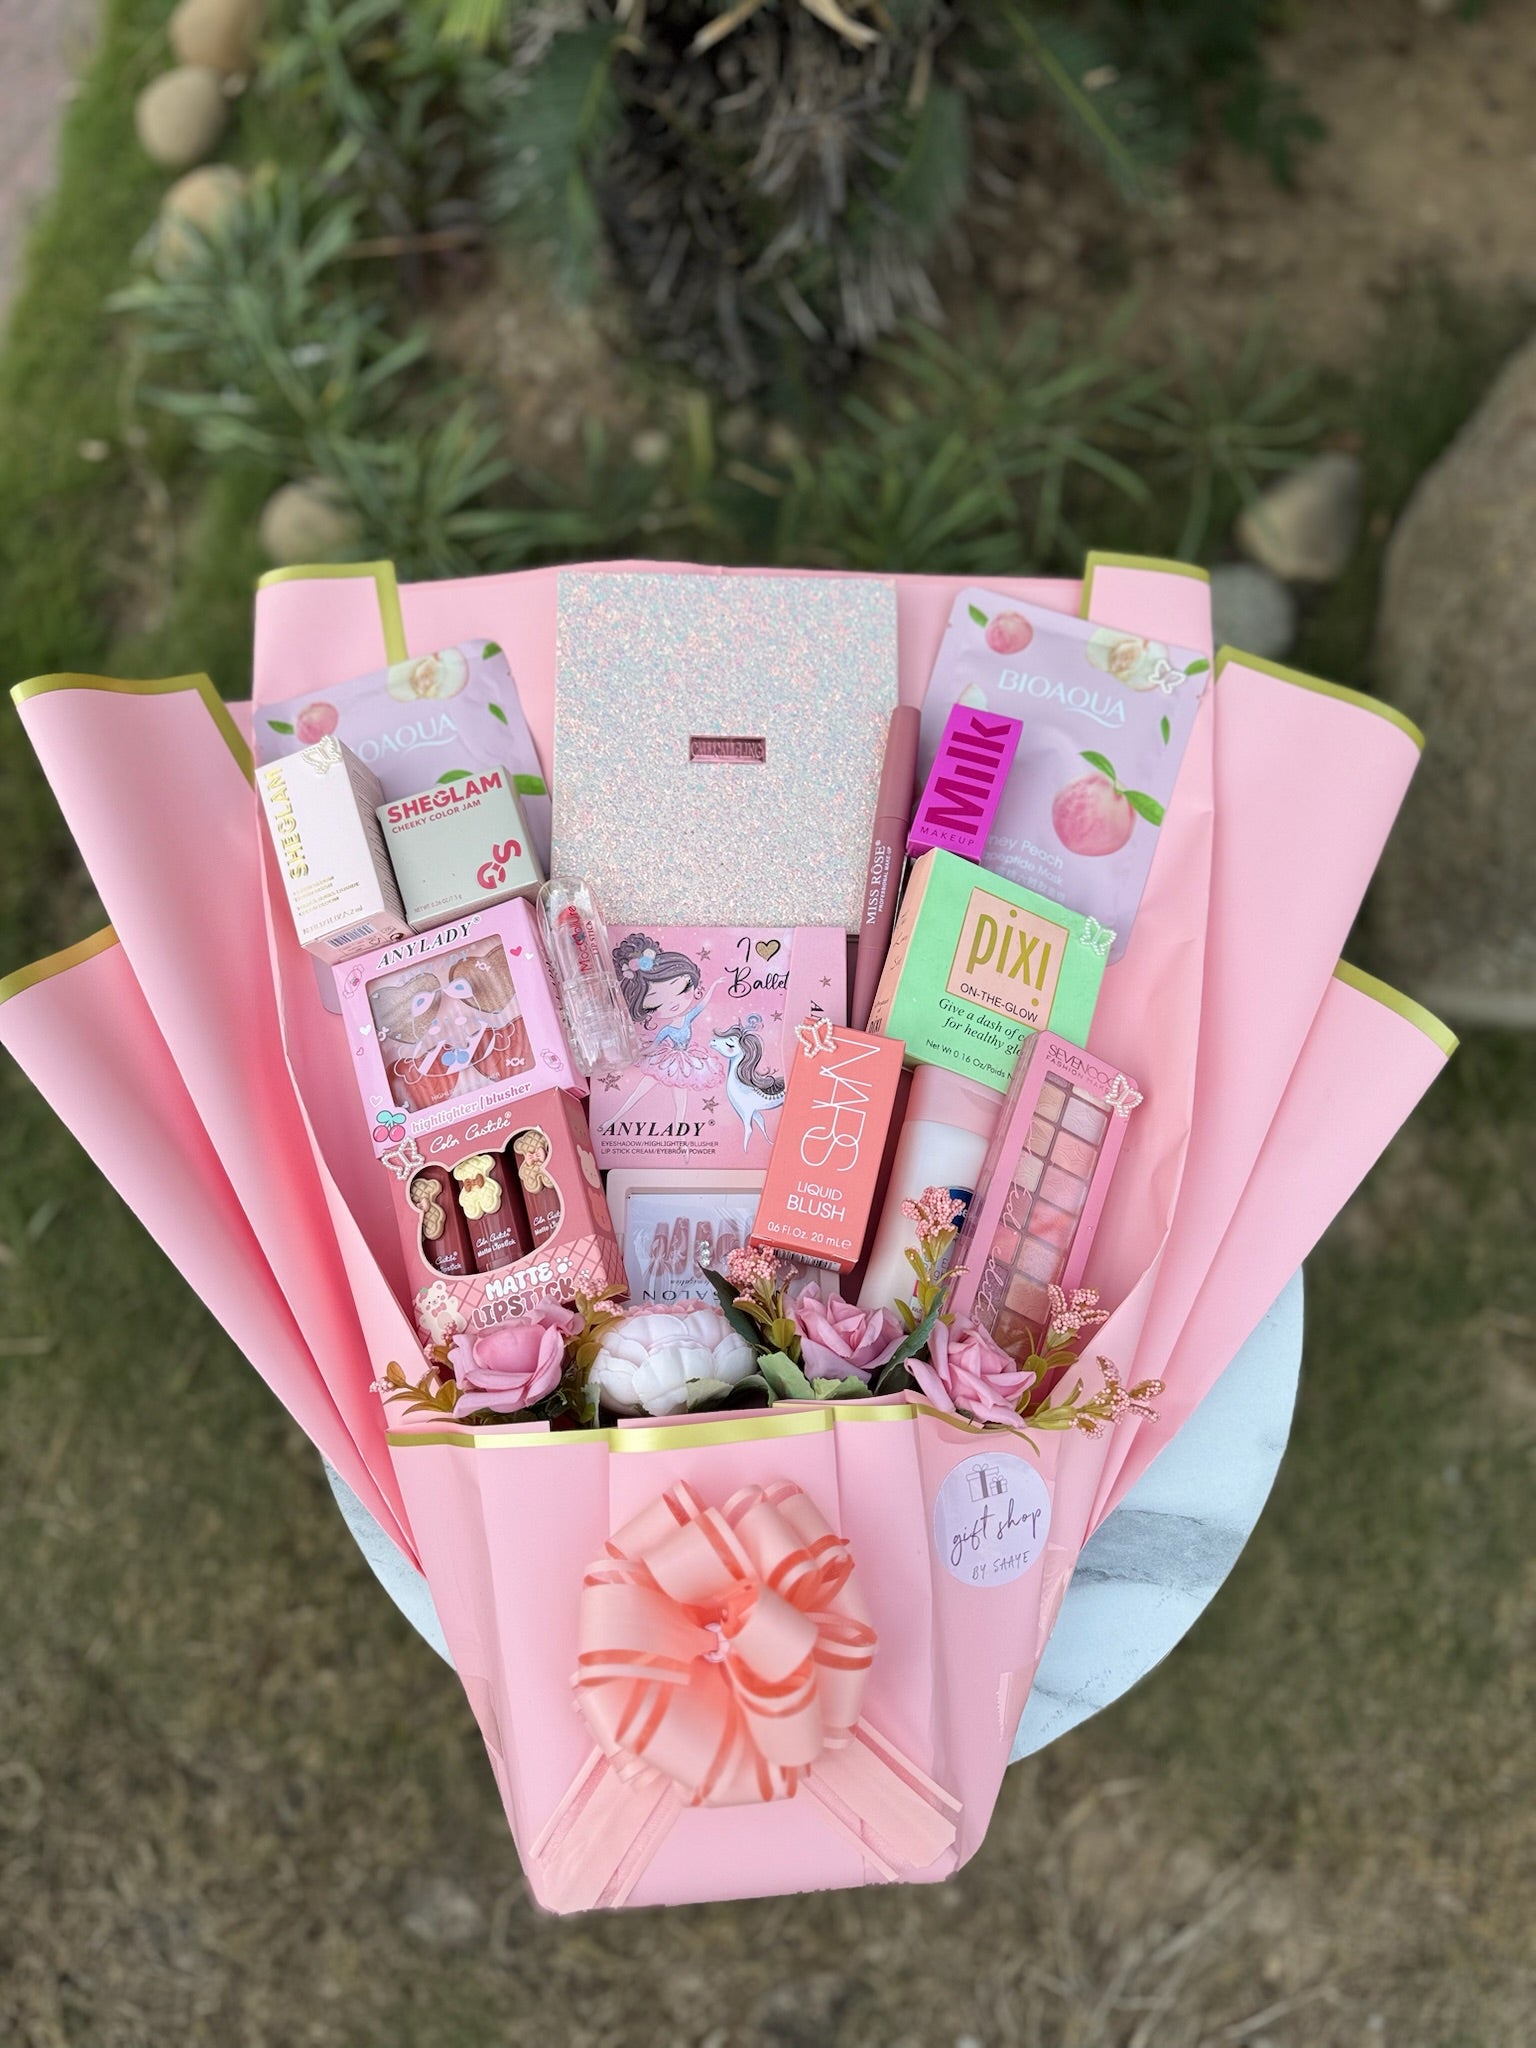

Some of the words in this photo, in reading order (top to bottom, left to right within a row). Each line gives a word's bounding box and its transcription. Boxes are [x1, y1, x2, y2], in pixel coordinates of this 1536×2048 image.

[997, 668, 1125, 722] BIOAQUA
[358, 712, 459, 762] OAQUA
[924, 716, 1012, 836] Milk
[387, 772, 503, 824] SHEGLAM
[391, 817, 427, 834] CHEEKY
[429, 807, 460, 822] COLOR
[462, 799, 481, 812] JAM
[264, 767, 309, 880] SHEGLAM
[920, 826, 975, 847] MAKEUP
[987, 836, 1017, 851] ney
[1021, 840, 1064, 869] Peach
[865, 887, 880, 924] MISS
[377, 922, 473, 969] ANYLADY
[724, 966, 790, 999] Ballet
[939, 998, 965, 1016] Give
[966, 1012, 975, 1021] a
[976, 1014, 1003, 1033] dash
[1004, 1028, 1020, 1040] of
[960, 983, 1039, 1023] ON-THE-GLOW
[926, 1039, 940, 1050] Net
[941, 1016, 963, 1031] for
[964, 1024, 1005, 1050] healthy
[1004, 1044, 1024, 1056] glo
[1046, 1054, 1084, 1079] FASHION
[800, 1036, 881, 1172] NARS
[430, 1134, 460, 1154] Color
[601, 1121, 706, 1137] ANYLADY
[786, 1194, 846, 1222] BLUSH
[797, 1181, 843, 1202] LIQUID
[811, 1231, 824, 1243] 20
[485, 1262, 554, 1301] MATTE
[472, 1277, 576, 1330] LIPSTICK
[950, 1504, 996, 1567] gift
[996, 1498, 1042, 1540] shop
[972, 1564, 987, 1581] BY
